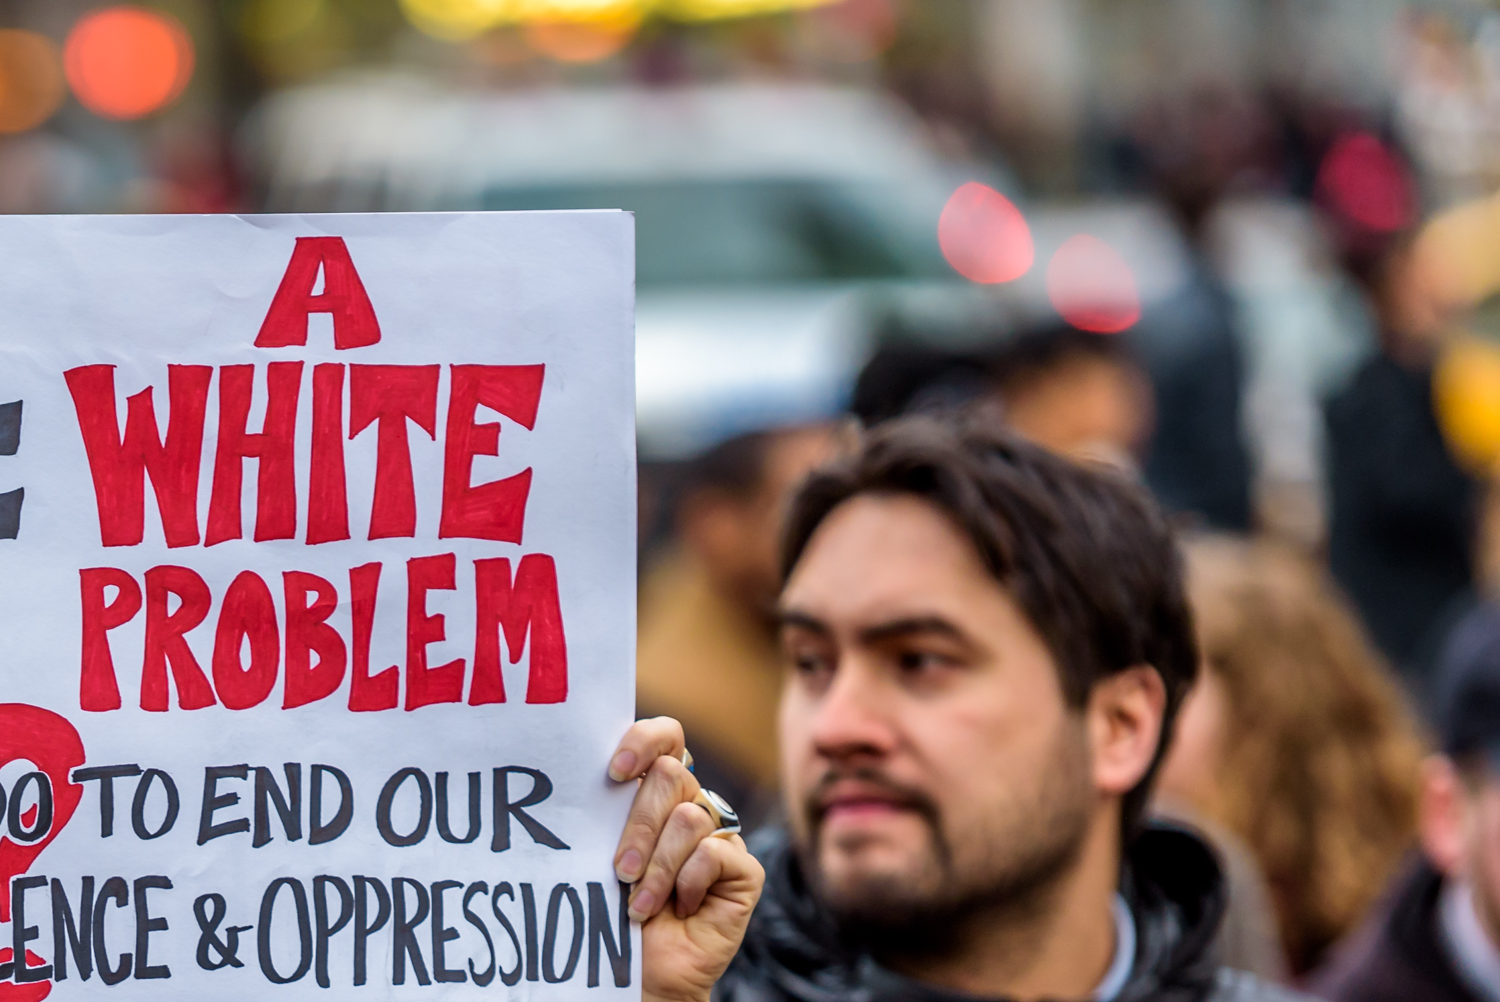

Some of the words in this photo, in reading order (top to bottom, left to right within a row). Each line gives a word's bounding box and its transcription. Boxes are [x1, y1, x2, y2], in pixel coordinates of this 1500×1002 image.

[253, 236, 381, 350] A
[63, 360, 546, 548] WHITE
[79, 552, 568, 712] PROBLEM
[71, 763, 180, 841] TO
[196, 762, 354, 848] END
[376, 765, 571, 852] OUR
[193, 892, 254, 971] &
[257, 874, 632, 989] OPPRESSION
